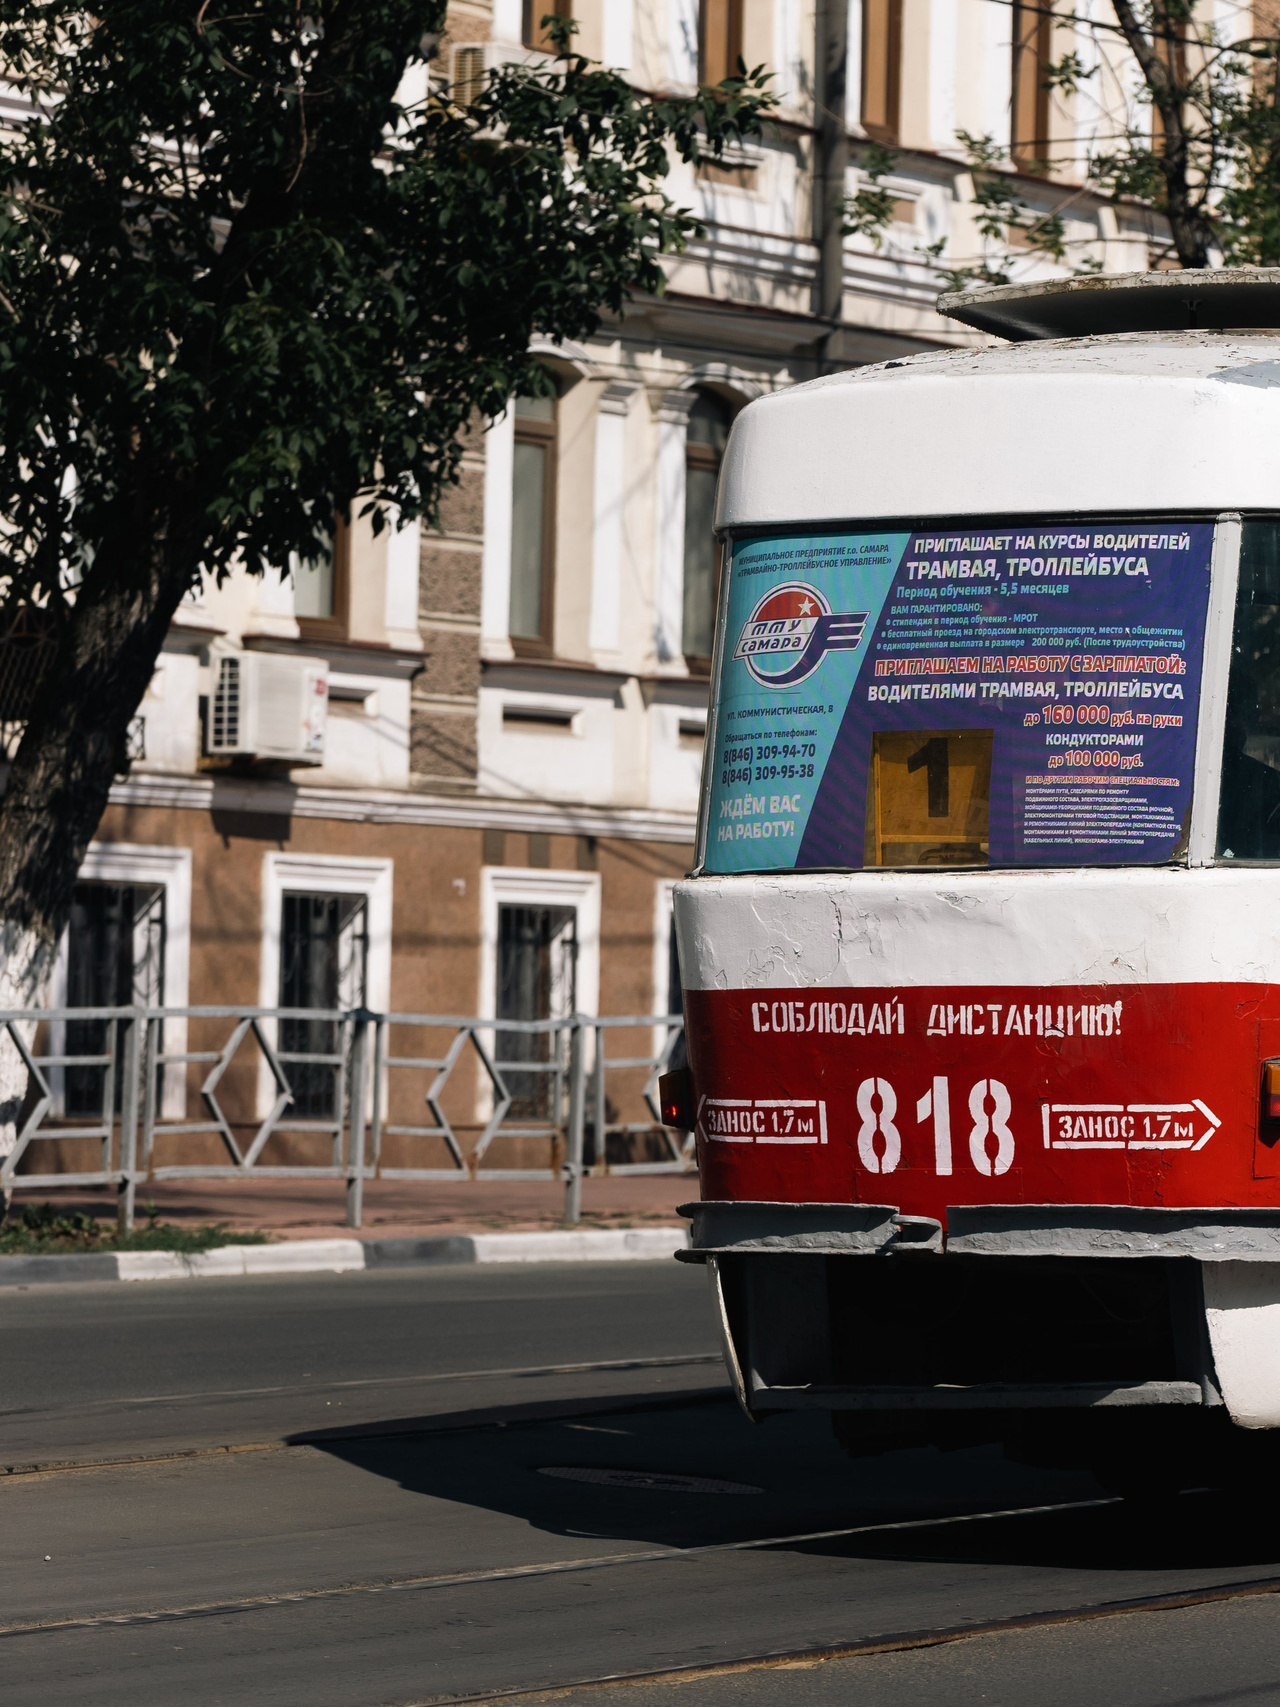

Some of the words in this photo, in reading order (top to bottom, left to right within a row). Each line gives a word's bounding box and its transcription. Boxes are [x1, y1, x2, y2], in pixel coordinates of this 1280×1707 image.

[914, 536, 1012, 553] ПРИГЛАШАЕТ
[1015, 536, 1035, 550] НА
[1038, 534, 1090, 550] КУРСЫ
[1094, 532, 1190, 551] ВОДИТЕЛЕЙ
[738, 550, 793, 566] МУНИЦИПАЛЬНОЕ
[795, 547, 846, 559] ПРЕДПРИЯТИЕ
[860, 544, 889, 554] САМАРА
[738, 559, 839, 577] «ТРАМВАЙНО-ТРОЛЛЕЙБУСНОЕ
[840, 556, 892, 568] УПРАВЛЕНИЕ»
[906, 558, 1001, 580] ТРАМВАЯ,
[1006, 553, 1149, 576] ТРОЛЛЕЙБУСА
[896, 586, 938, 600] Период
[940, 584, 992, 598] обучения
[1000, 582, 1018, 596] 5,5
[1020, 584, 1070, 595] месяцев
[890, 606, 908, 614] ВАМ
[910, 603, 982, 614] ГАРАНТИРОВАНО:
[892, 618, 932, 626] стипендия
[940, 617, 969, 626] период
[970, 614, 1007, 625] обучения
[1013, 614, 1038, 622] МРОТ
[888, 628, 932, 638] бесплатный
[934, 628, 962, 638] проезд
[963, 628, 973, 636] на
[974, 627, 1017, 638] городском
[1018, 626, 1097, 636] электротранспорте,
[1099, 626, 1123, 634] место
[1132, 625, 1183, 636] общежитии
[882, 641, 948, 651] единовременная
[950, 639, 983, 648] выплата
[992, 638, 1025, 648] размере
[1032, 637, 1047, 646] 200
[1048, 638, 1064, 646] 000
[1065, 637, 1082, 648] руб.
[1083, 636, 1111, 648] (После
[1112, 638, 1186, 650] трудоустройства)
[875, 656, 980, 676] ПРИГЛАШАЕМ
[982, 656, 1004, 673] НА
[1006, 656, 1070, 673] РАБОТУ
[1070, 655, 1081, 672] С
[1082, 654, 1186, 675] ЗАРПЛАТОЙ:
[868, 682, 976, 704] ВОДИТЕЛЯМИ
[980, 682, 1060, 700] ТРАМВАЯ,
[1064, 678, 1184, 700] ТРОЛЛЕЙБУСА
[738, 705, 826, 718] КОММУНИСТИЧЕСКАЯ,
[828, 704, 834, 713] 8
[1024, 714, 1040, 726] до
[1042, 705, 1074, 724] 160
[1076, 705, 1110, 724] 000
[1110, 710, 1134, 728] руб.
[1136, 714, 1152, 724] на
[1152, 714, 1183, 728] руки
[725, 732, 762, 743] Обращаться
[764, 731, 772, 740] по
[774, 728, 818, 740] телефонам:
[1046, 734, 1144, 746] КОНДУКТОРАМИ
[723, 746, 754, 767] 8(846)
[756, 744, 816, 760] 309-94-70
[1048, 756, 1064, 768] до
[1065, 750, 1091, 766] 100
[1092, 750, 1120, 766] 000
[1120, 754, 1144, 770] руб.
[722, 766, 752, 788] 8(846)
[755, 764, 814, 780] 309-95-38
[907, 737, 949, 818] 1
[1026, 776, 1032, 784] И
[1032, 776, 1043, 784] ПО
[1043, 776, 1074, 785] ДРУГИМ
[1074, 776, 1110, 784] РАБОЧИМ
[1110, 776, 1180, 787] СПЕЦИАЛЬНОСТЯМ:
[720, 793, 766, 820] ЖДЁМ
[769, 794, 802, 814] ВАС
[718, 824, 734, 842] НА
[735, 820, 795, 840] РАБОТУ!
[751, 995, 905, 1036] СОБЛЮДАЙ
[926, 1000, 1123, 1038] ДИСТАНЦИЮ!
[708, 1109, 766, 1134] ЗАНОС
[856, 1076, 1015, 1176] 818
[1058, 1115, 1135, 1140] ЗАНОС
